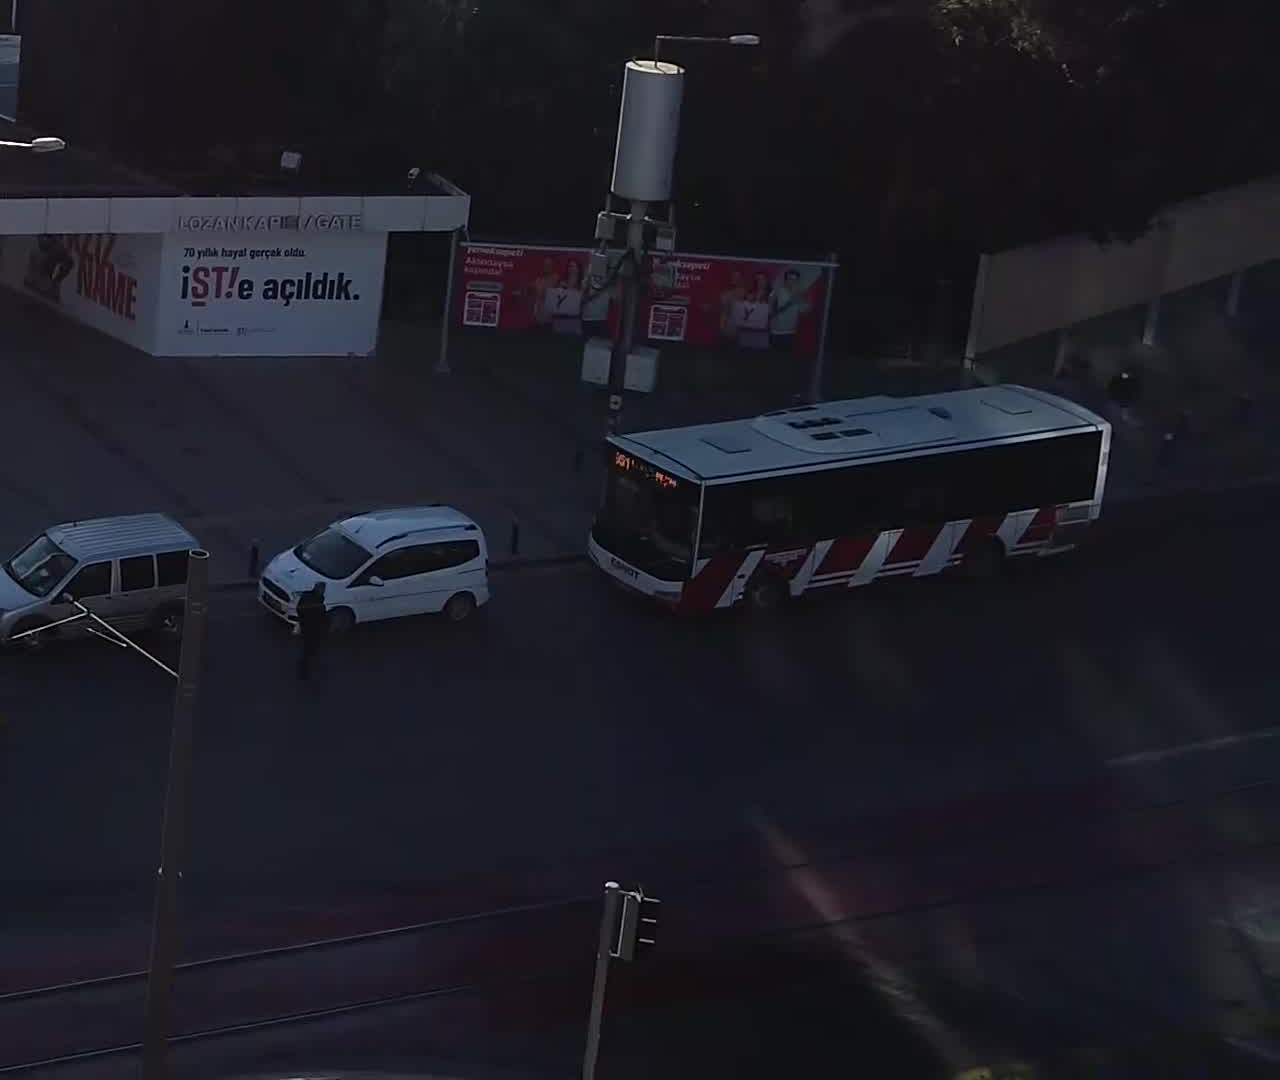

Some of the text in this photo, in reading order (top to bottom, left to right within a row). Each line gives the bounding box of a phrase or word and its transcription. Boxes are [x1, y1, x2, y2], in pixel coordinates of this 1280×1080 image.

[177, 215, 239, 232] LOZAN
[314, 214, 362, 232] GATE
[183, 247, 196, 258] 70
[221, 247, 247, 260] hayal
[262, 271, 361, 307] açıldık.
